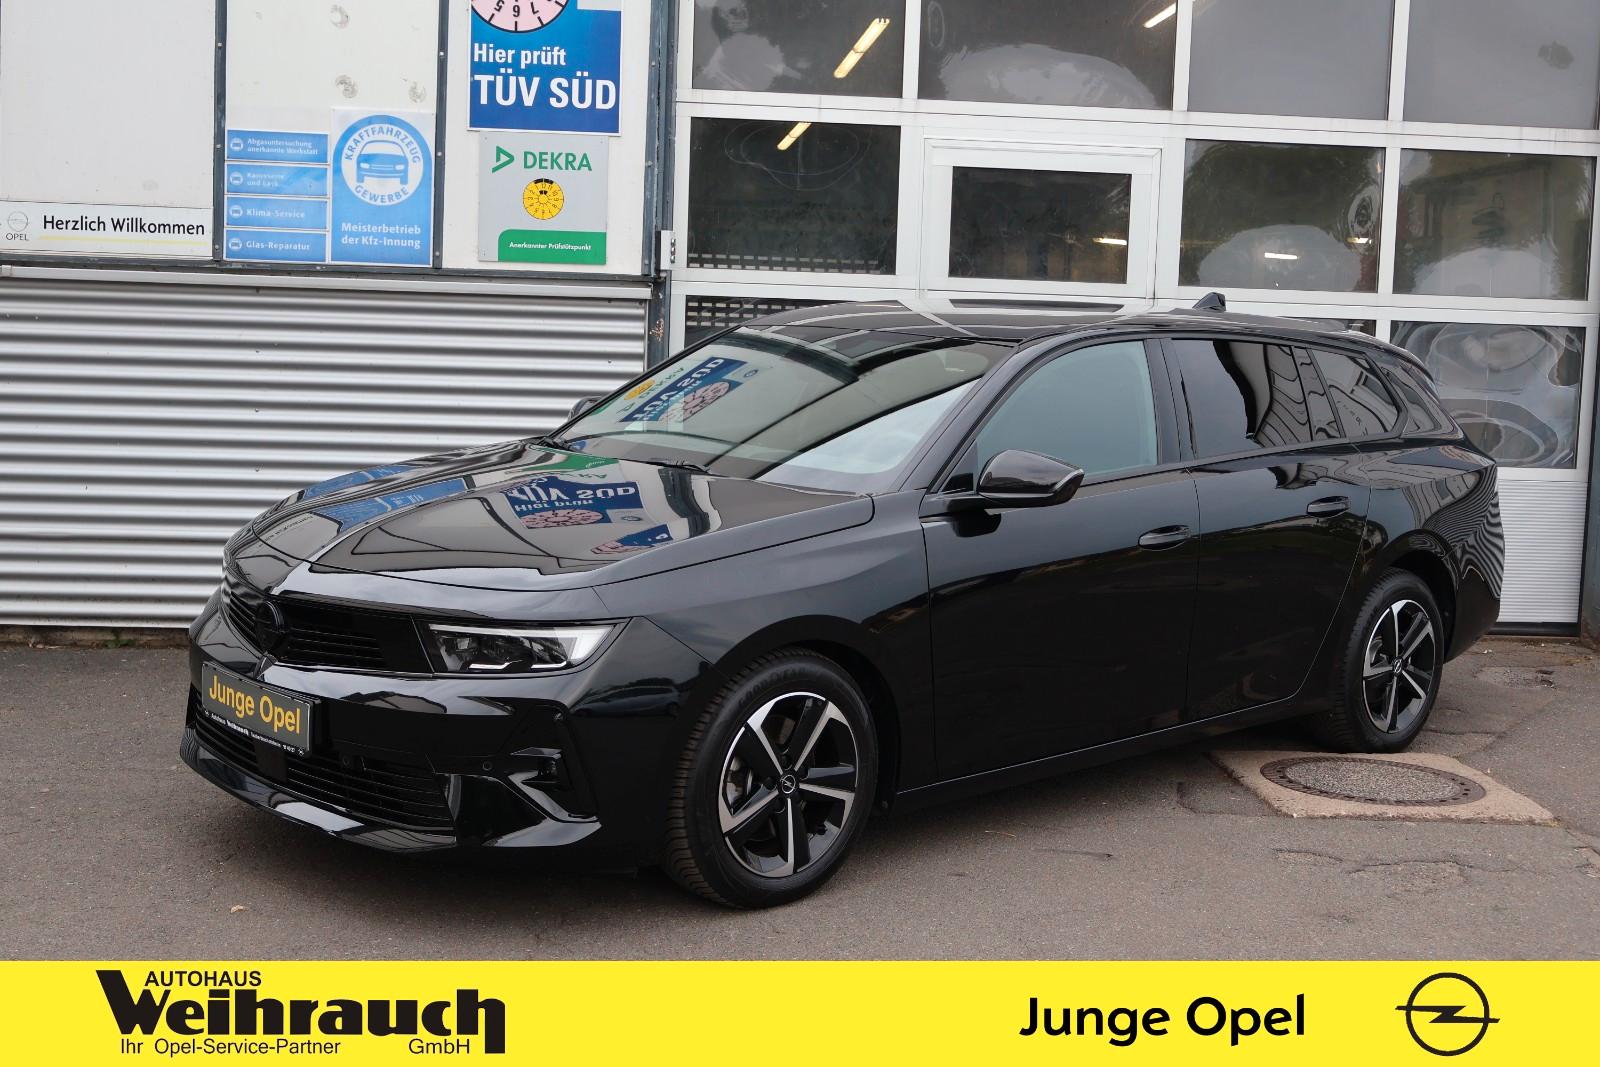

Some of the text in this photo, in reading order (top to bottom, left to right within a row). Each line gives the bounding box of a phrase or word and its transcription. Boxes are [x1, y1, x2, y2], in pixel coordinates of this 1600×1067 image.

[473, 43, 567, 69] Hier prüft
[473, 67, 616, 109] TÜV SÜD
[344, 126, 421, 163] KRAFTFAHRZEUG
[523, 150, 593, 171] DEKRA
[354, 185, 409, 203] GEWERBE
[246, 208, 305, 218] Klima-Service
[43, 215, 205, 236] Herzlich Willkommen
[341, 222, 421, 235] Meisterbetrieb
[6, 233, 28, 241] OPEL
[246, 241, 310, 251] Glas-Reparatur
[341, 235, 421, 249] der Kfz-Innung
[509, 242, 592, 252] Anerkannter Prüfstützpunkt
[209, 675, 300, 735] Junge Opel
